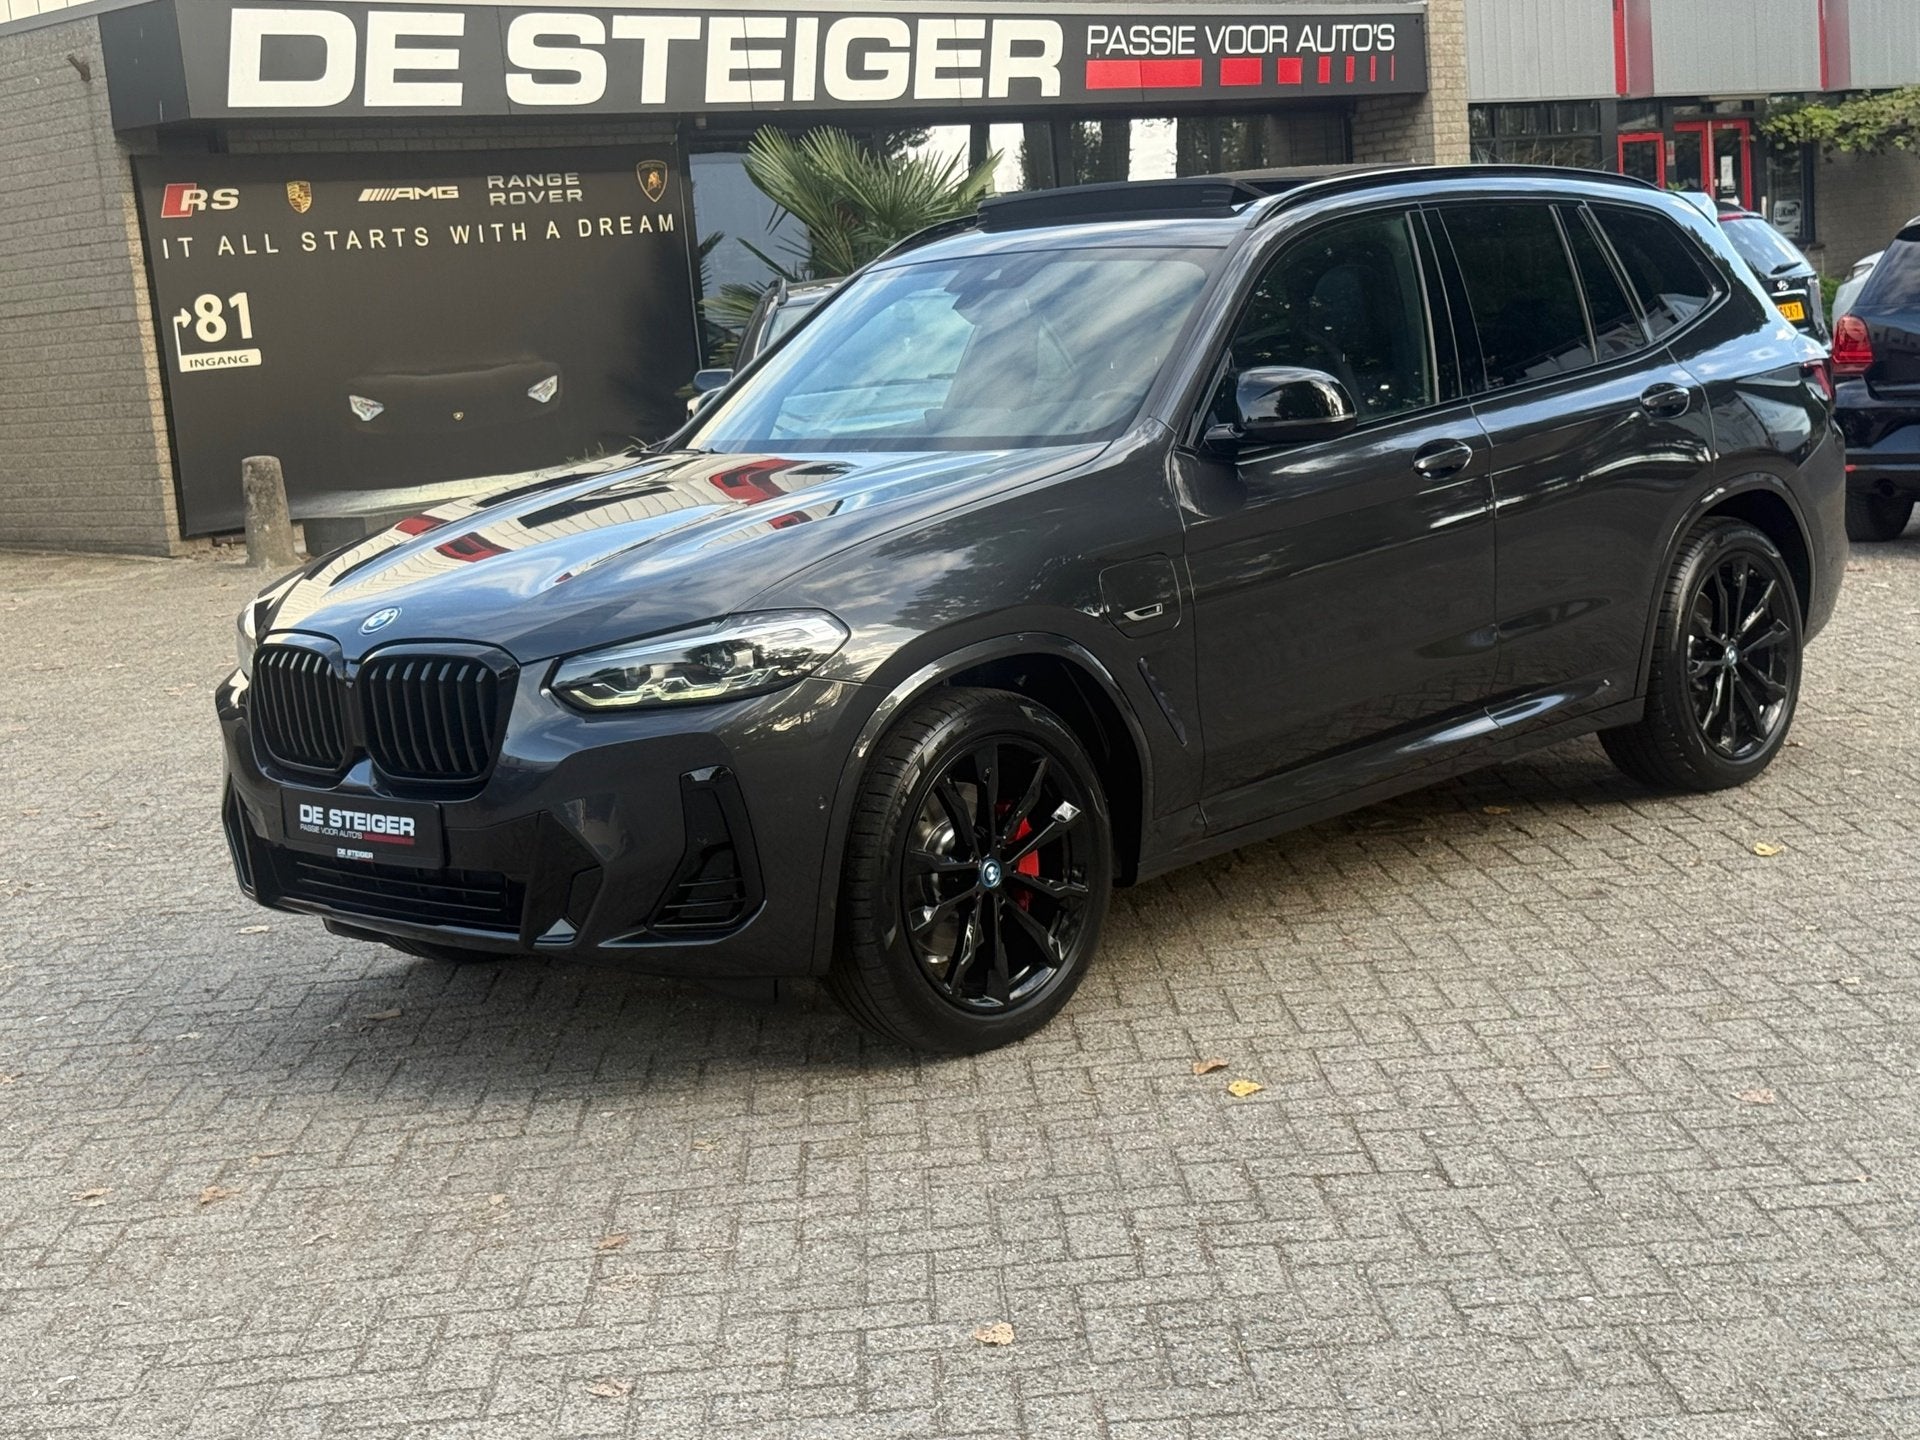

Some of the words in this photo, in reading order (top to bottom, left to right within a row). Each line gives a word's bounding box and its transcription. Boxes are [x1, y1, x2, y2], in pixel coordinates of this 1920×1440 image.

[1086, 25, 1196, 55] PASSIE
[1205, 25, 1288, 53] VOOR
[1296, 23, 1395, 53] AUTO'S
[227, 8, 466, 107] DE
[505, 12, 1064, 106] STEIGER
[487, 173, 580, 189] RANGE
[180, 188, 240, 211] RS
[391, 186, 459, 201] AMG
[489, 189, 583, 206] ROVER
[162, 237, 193, 260] IT
[217, 233, 279, 256] ALL
[301, 227, 430, 252] STARTS
[450, 222, 527, 245] WITH
[545, 220, 560, 239] A
[578, 213, 674, 238] DREAM
[194, 292, 252, 342] 81
[189, 355, 249, 368] INGANG
[300, 804, 324, 825] DE
[329, 808, 415, 836] STEIGER
[300, 823, 320, 834] PASSIE
[321, 826, 339, 836] VOOR
